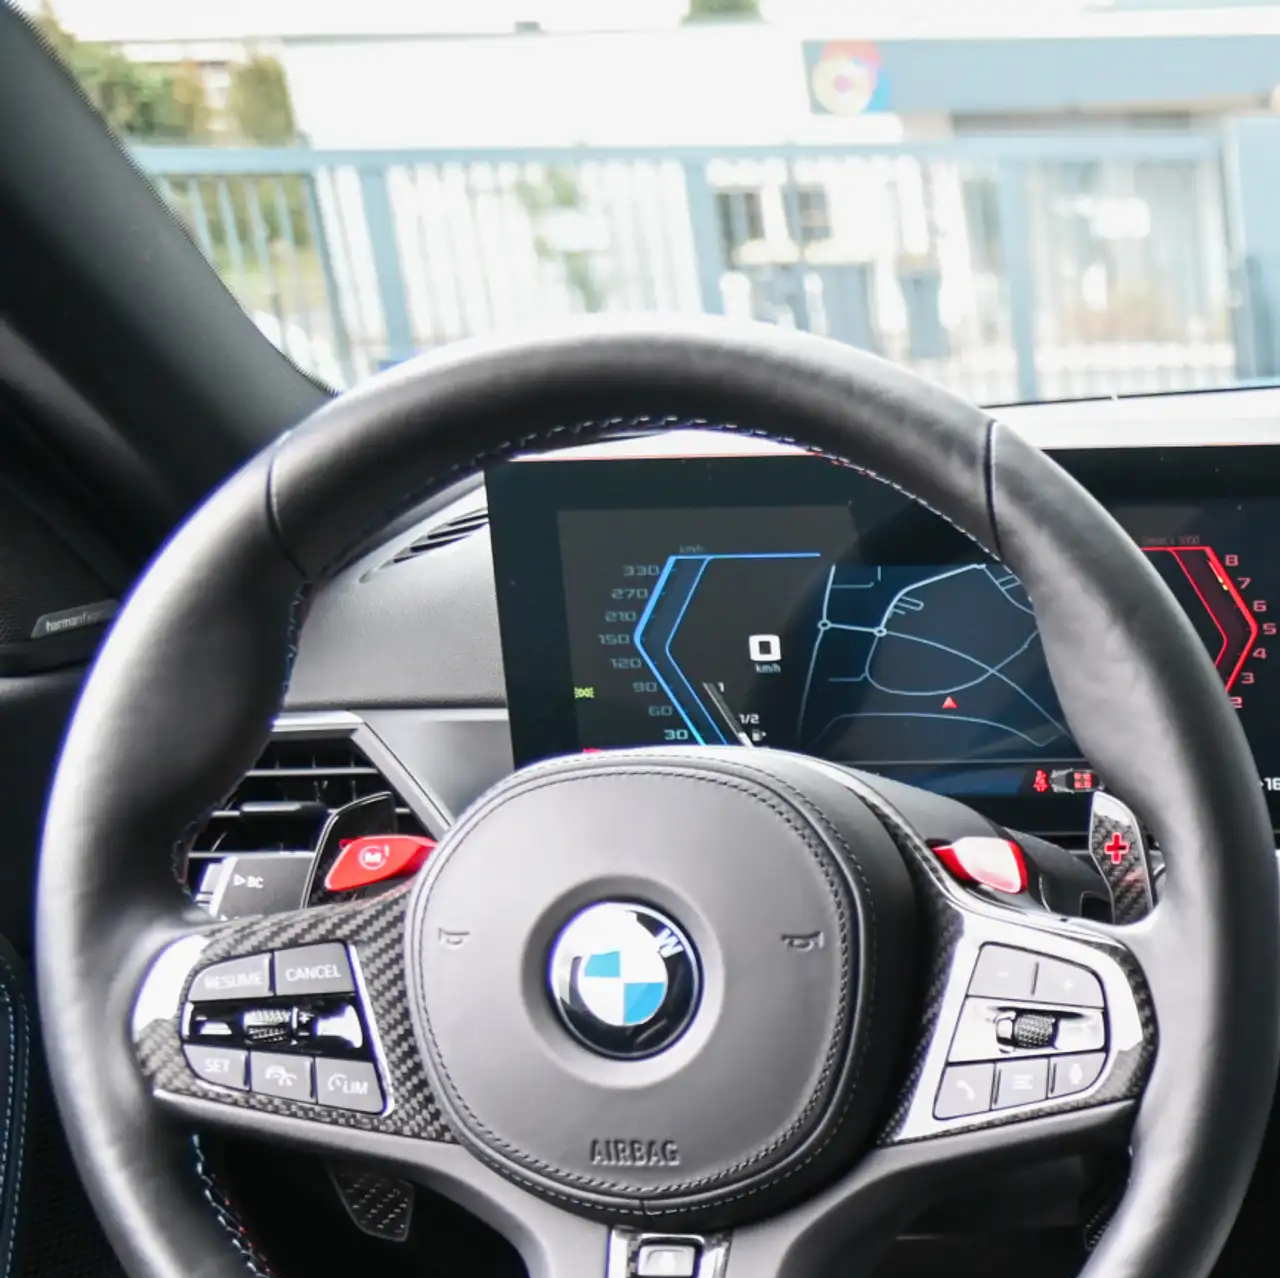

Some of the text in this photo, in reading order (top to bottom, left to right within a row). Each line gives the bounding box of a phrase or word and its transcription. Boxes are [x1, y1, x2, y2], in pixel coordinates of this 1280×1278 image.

[1224, 554, 1239, 567] 8
[623, 564, 660, 577] 330
[1237, 577, 1251, 590] 7
[611, 588, 649, 599] 270
[1252, 600, 1267, 613] 6
[605, 610, 637, 622] 210
[1262, 622, 1277, 636] 5
[598, 634, 631, 645] 150
[748, 634, 782, 662] 0
[1252, 648, 1268, 660] 4
[610, 658, 642, 669] 120
[754, 663, 782, 673] km/h
[1241, 672, 1255, 685] 3
[632, 682, 658, 693] 90
[1229, 696, 1243, 709] 2
[648, 705, 673, 716] 60
[738, 714, 760, 725] 1/2
[664, 729, 688, 740] 30
[285, 963, 342, 982] CANCEL
[204, 970, 264, 990] RESUME
[203, 1058, 231, 1073] SET
[343, 1081, 369, 1095] LIM
[590, 1139, 681, 1167] AIRBAG
